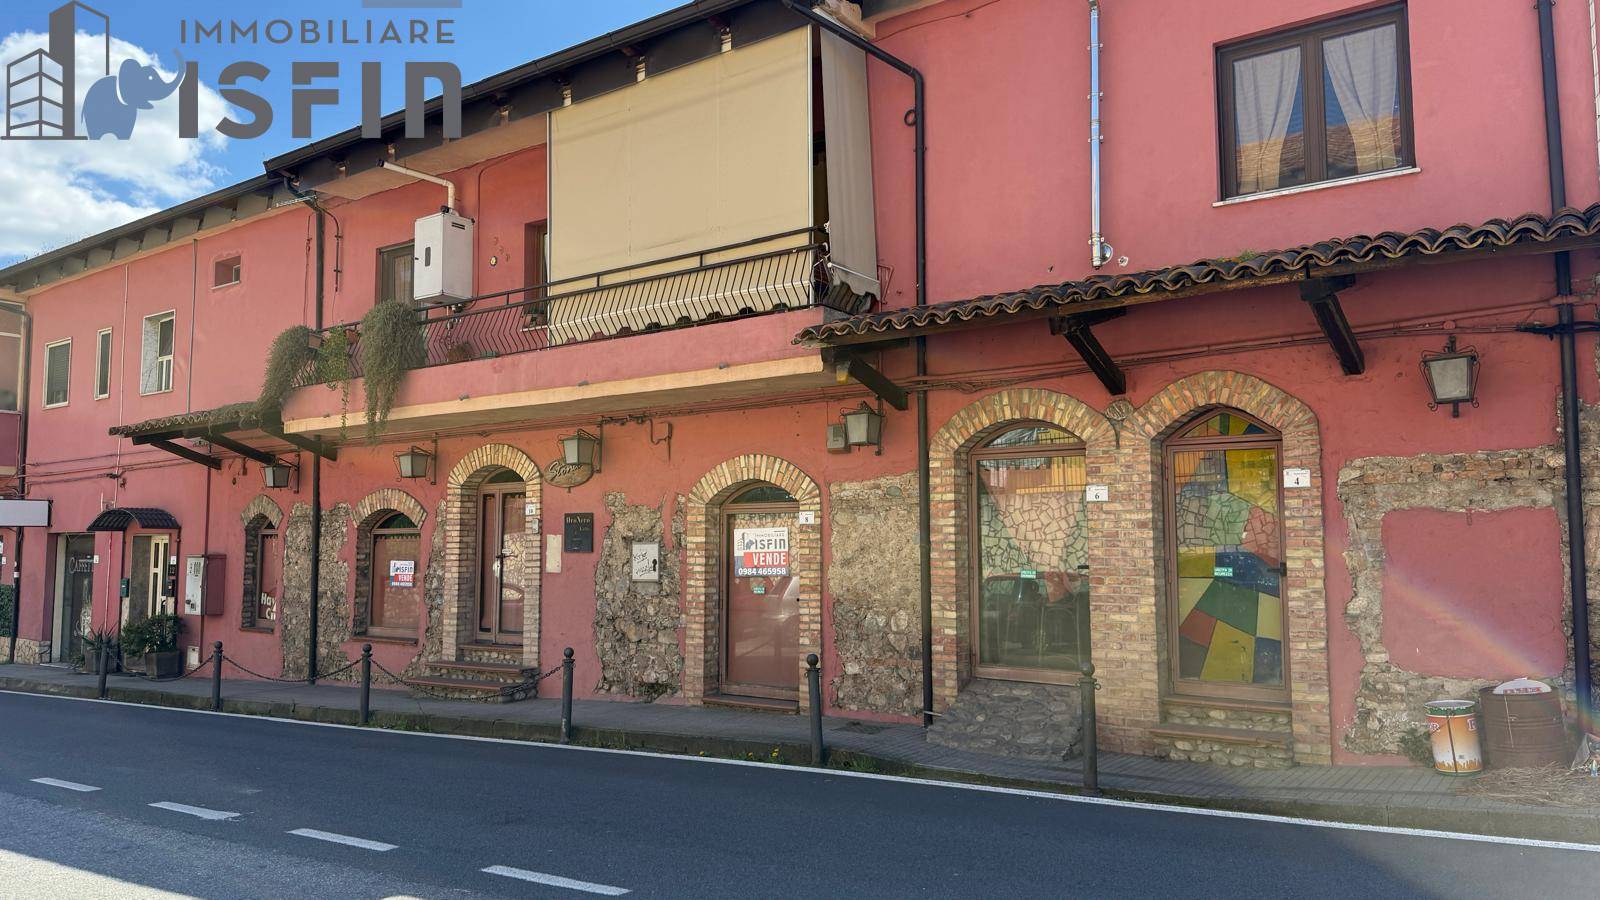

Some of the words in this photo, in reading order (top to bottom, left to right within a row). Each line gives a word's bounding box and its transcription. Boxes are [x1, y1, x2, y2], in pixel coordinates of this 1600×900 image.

[752, 552, 787, 566] VENDE
[738, 567, 756, 575] 0984
[757, 567, 787, 575] 465958
